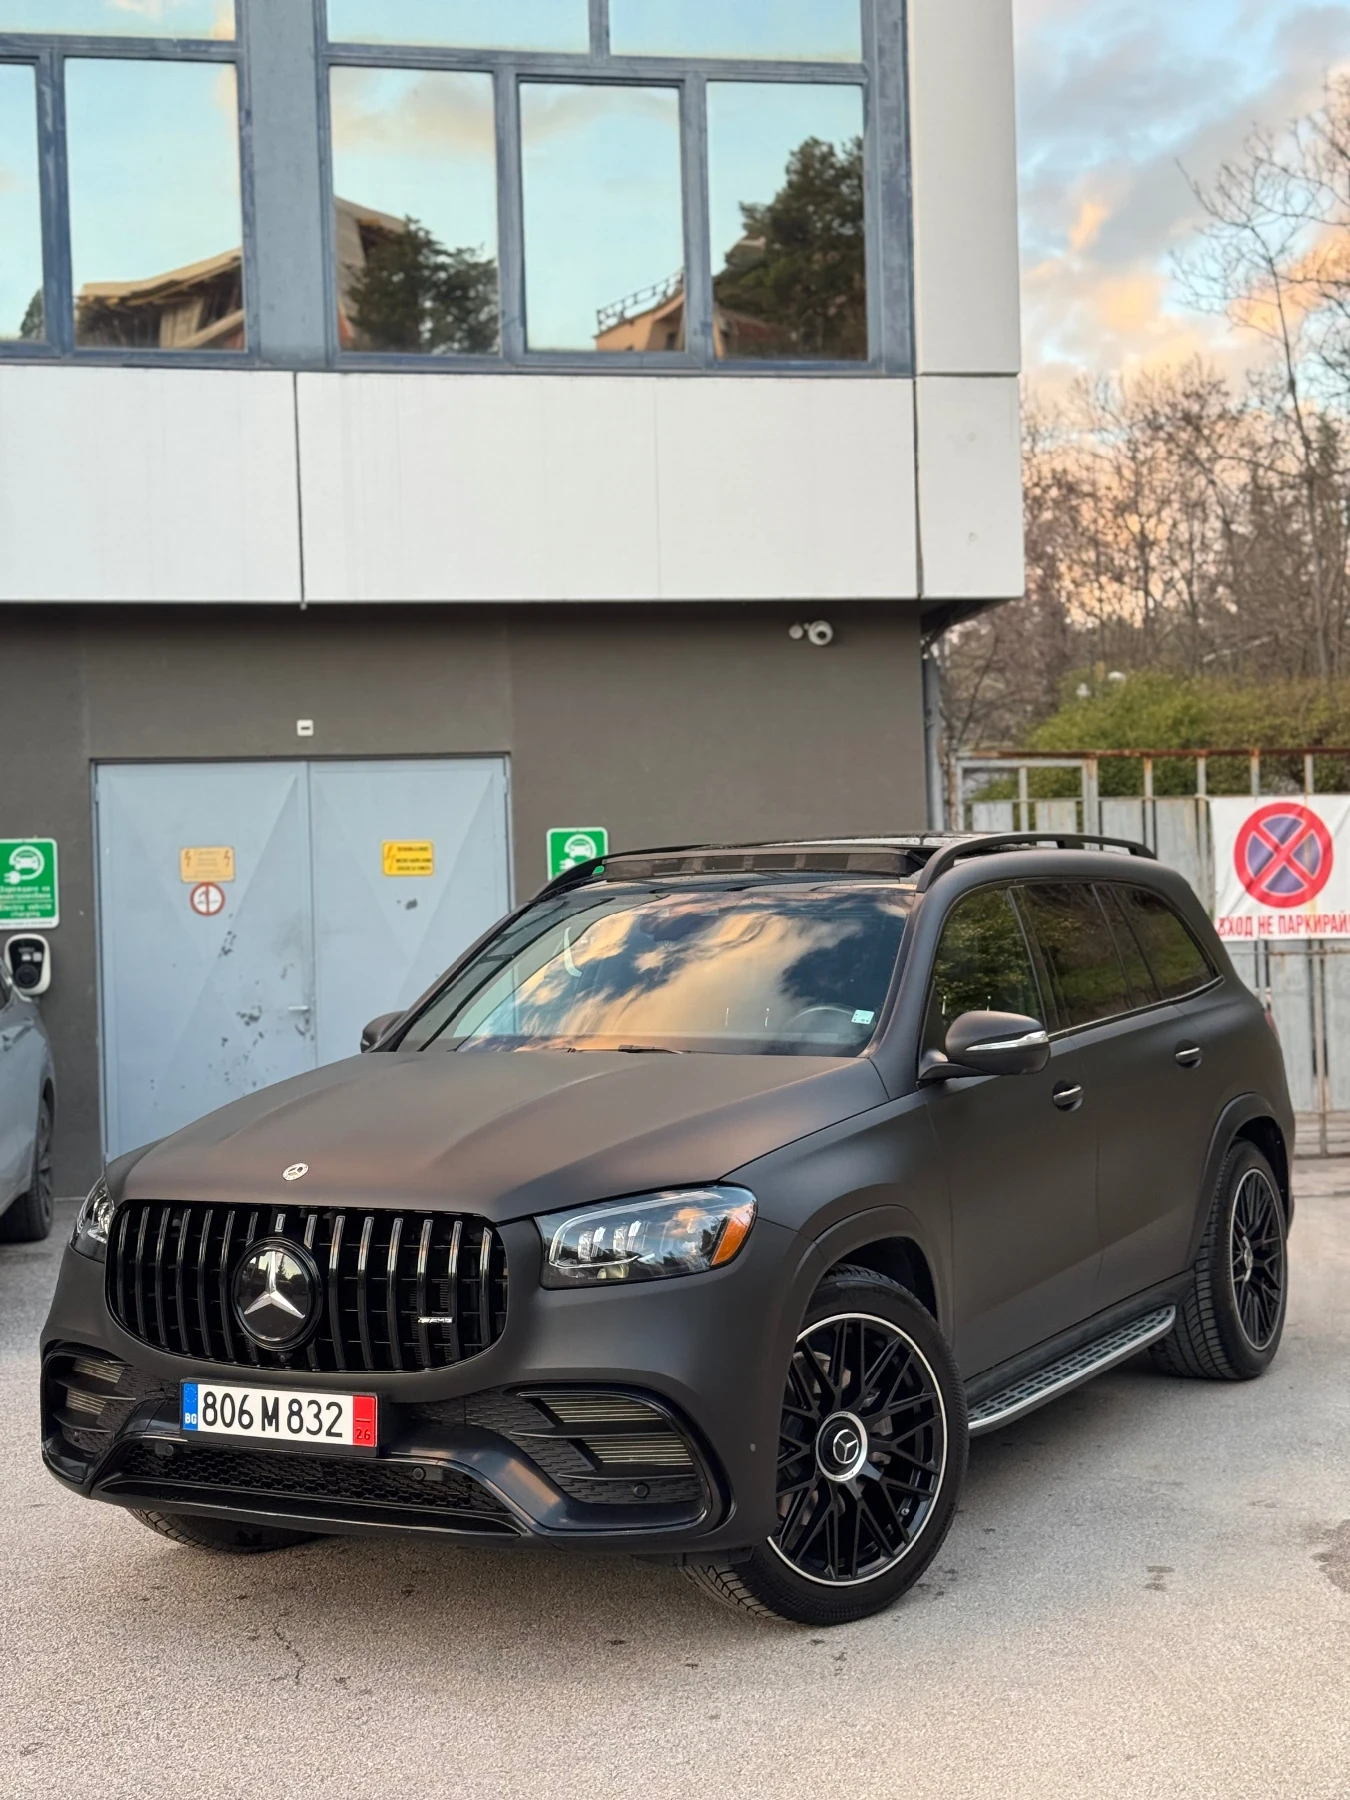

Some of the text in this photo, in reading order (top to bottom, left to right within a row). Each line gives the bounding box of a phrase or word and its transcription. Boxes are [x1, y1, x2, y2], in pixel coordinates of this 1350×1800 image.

[1217, 909, 1350, 937] ВХОД НЕ ПАРКИРАЙ
[184, 1412, 197, 1425] BG
[202, 1391, 254, 1430] 806
[286, 1398, 343, 1438] 832
[356, 1428, 371, 1441] 26
